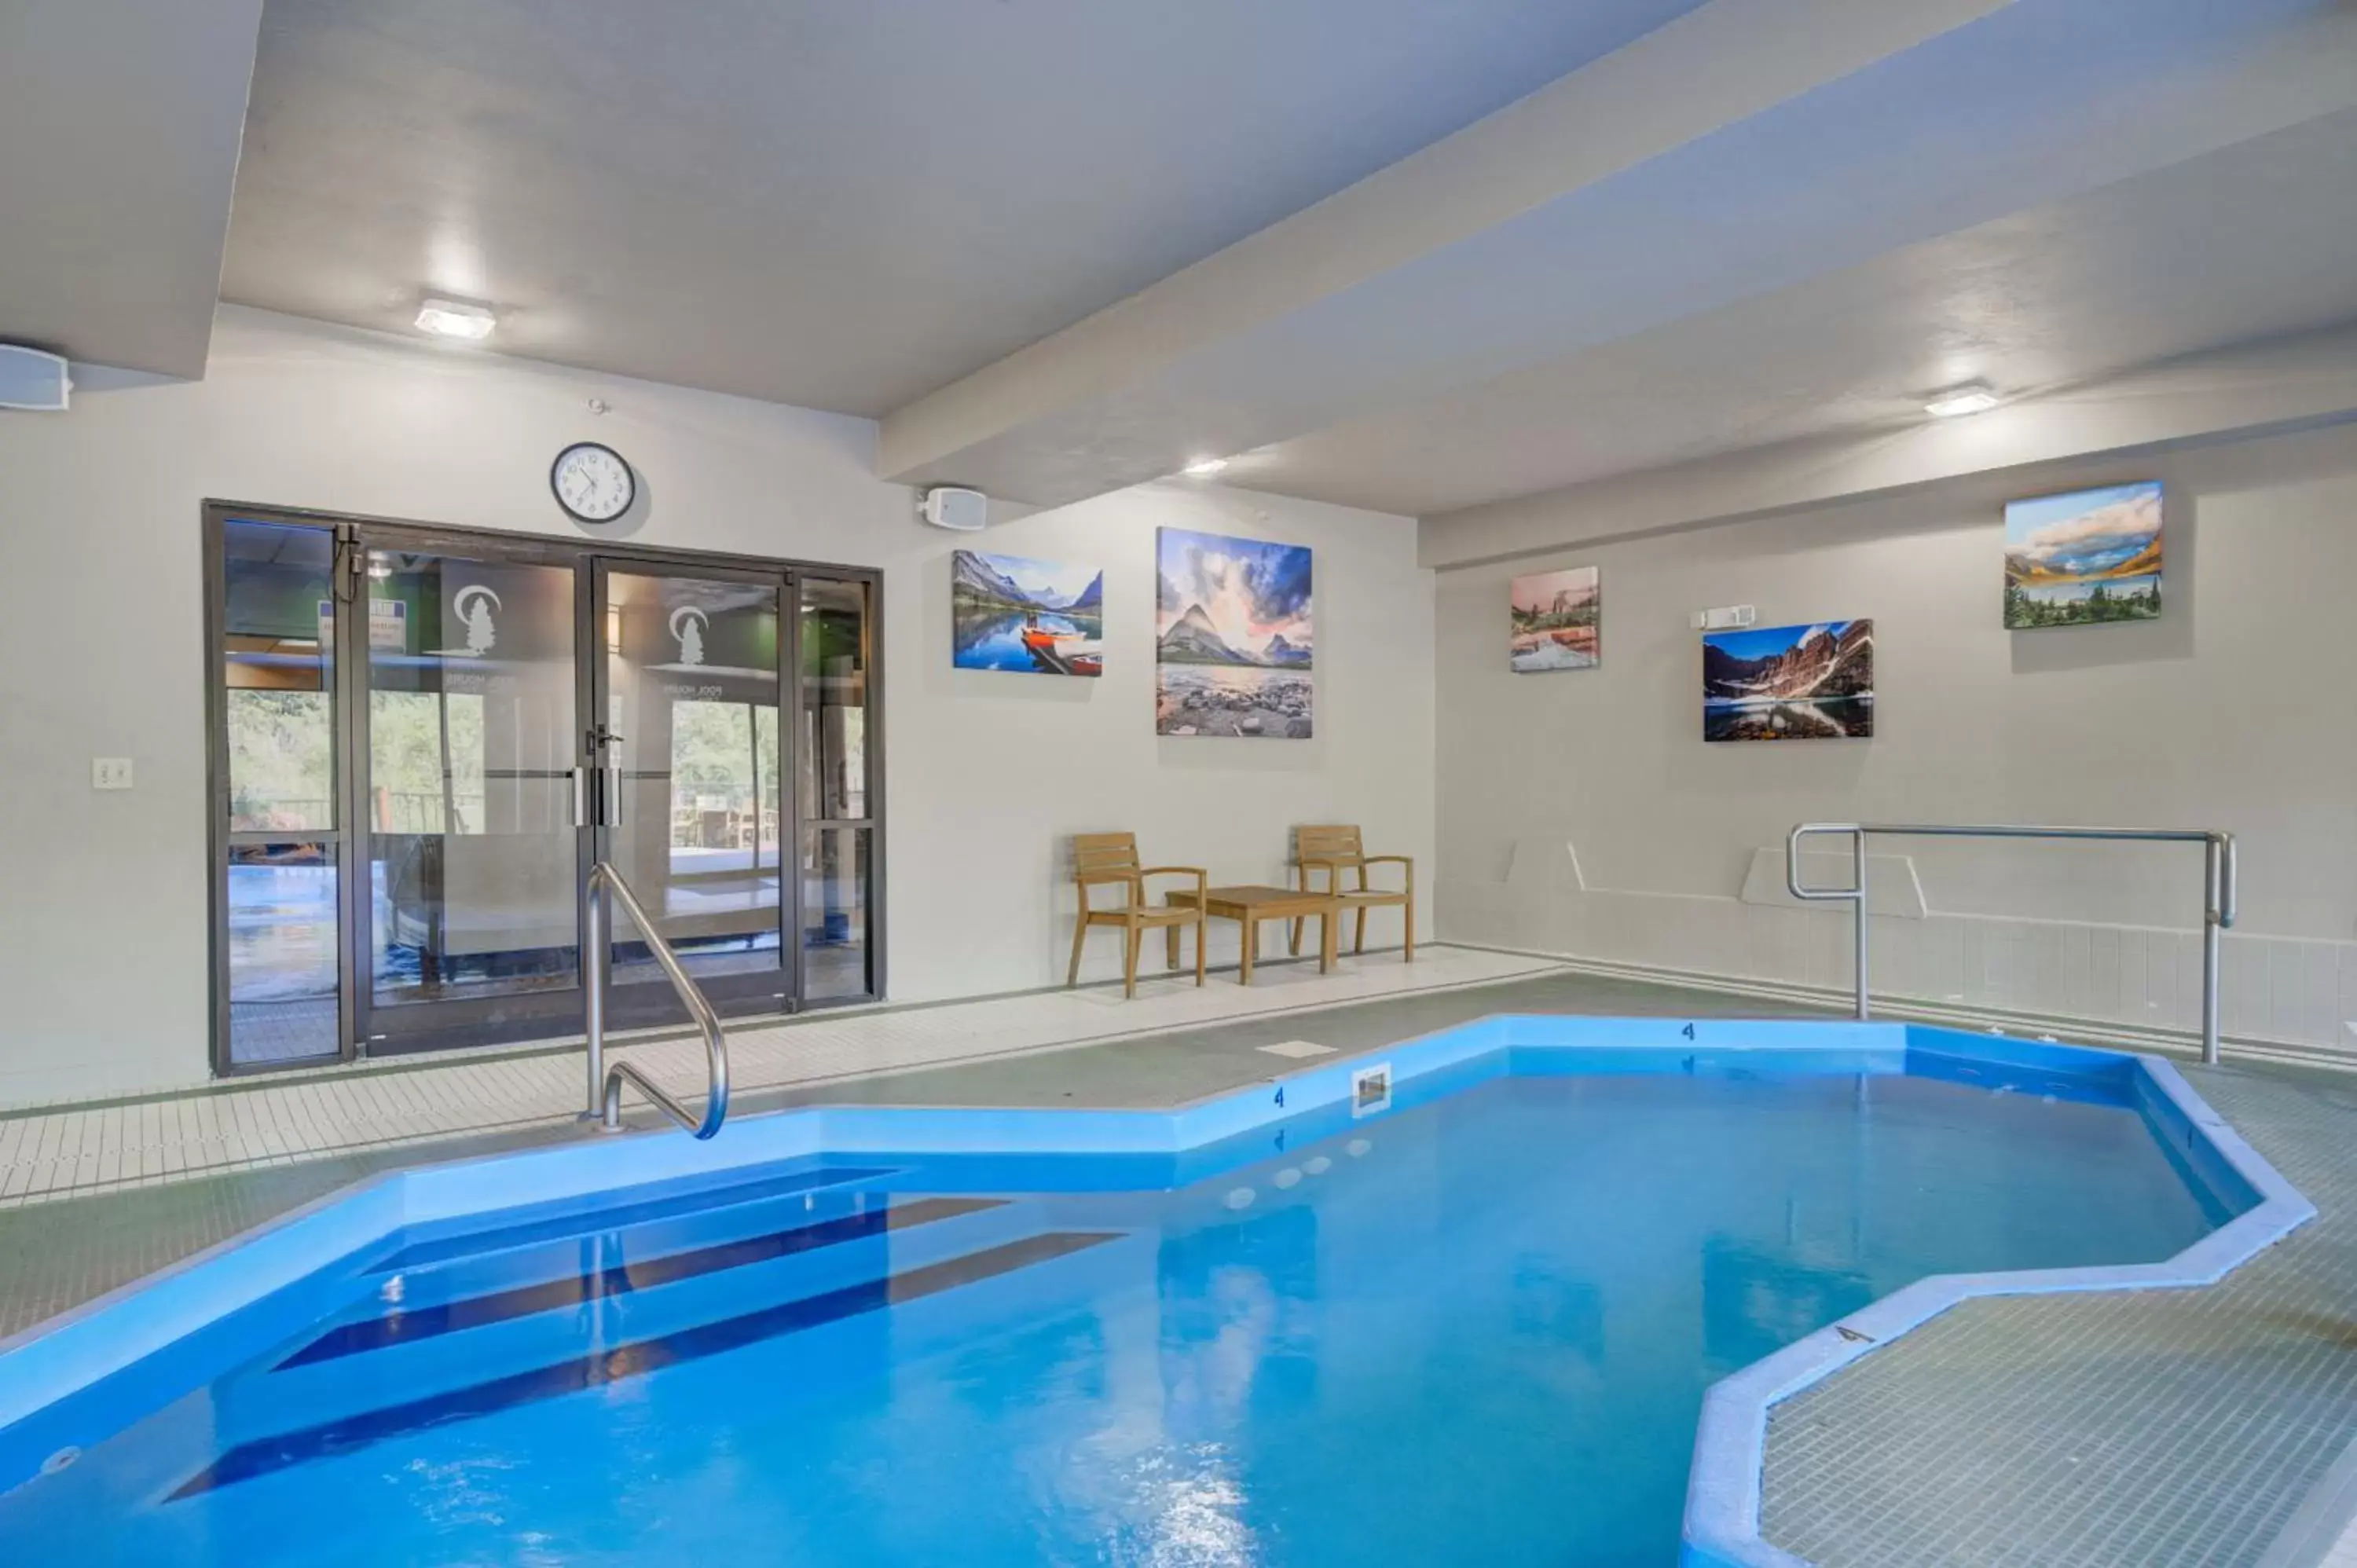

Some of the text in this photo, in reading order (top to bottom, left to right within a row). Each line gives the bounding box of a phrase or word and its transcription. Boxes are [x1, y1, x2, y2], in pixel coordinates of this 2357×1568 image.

[1682, 1022, 1695, 1040] 4
[1274, 1086, 1284, 1107] 4
[1834, 1325, 1876, 1343] 4
